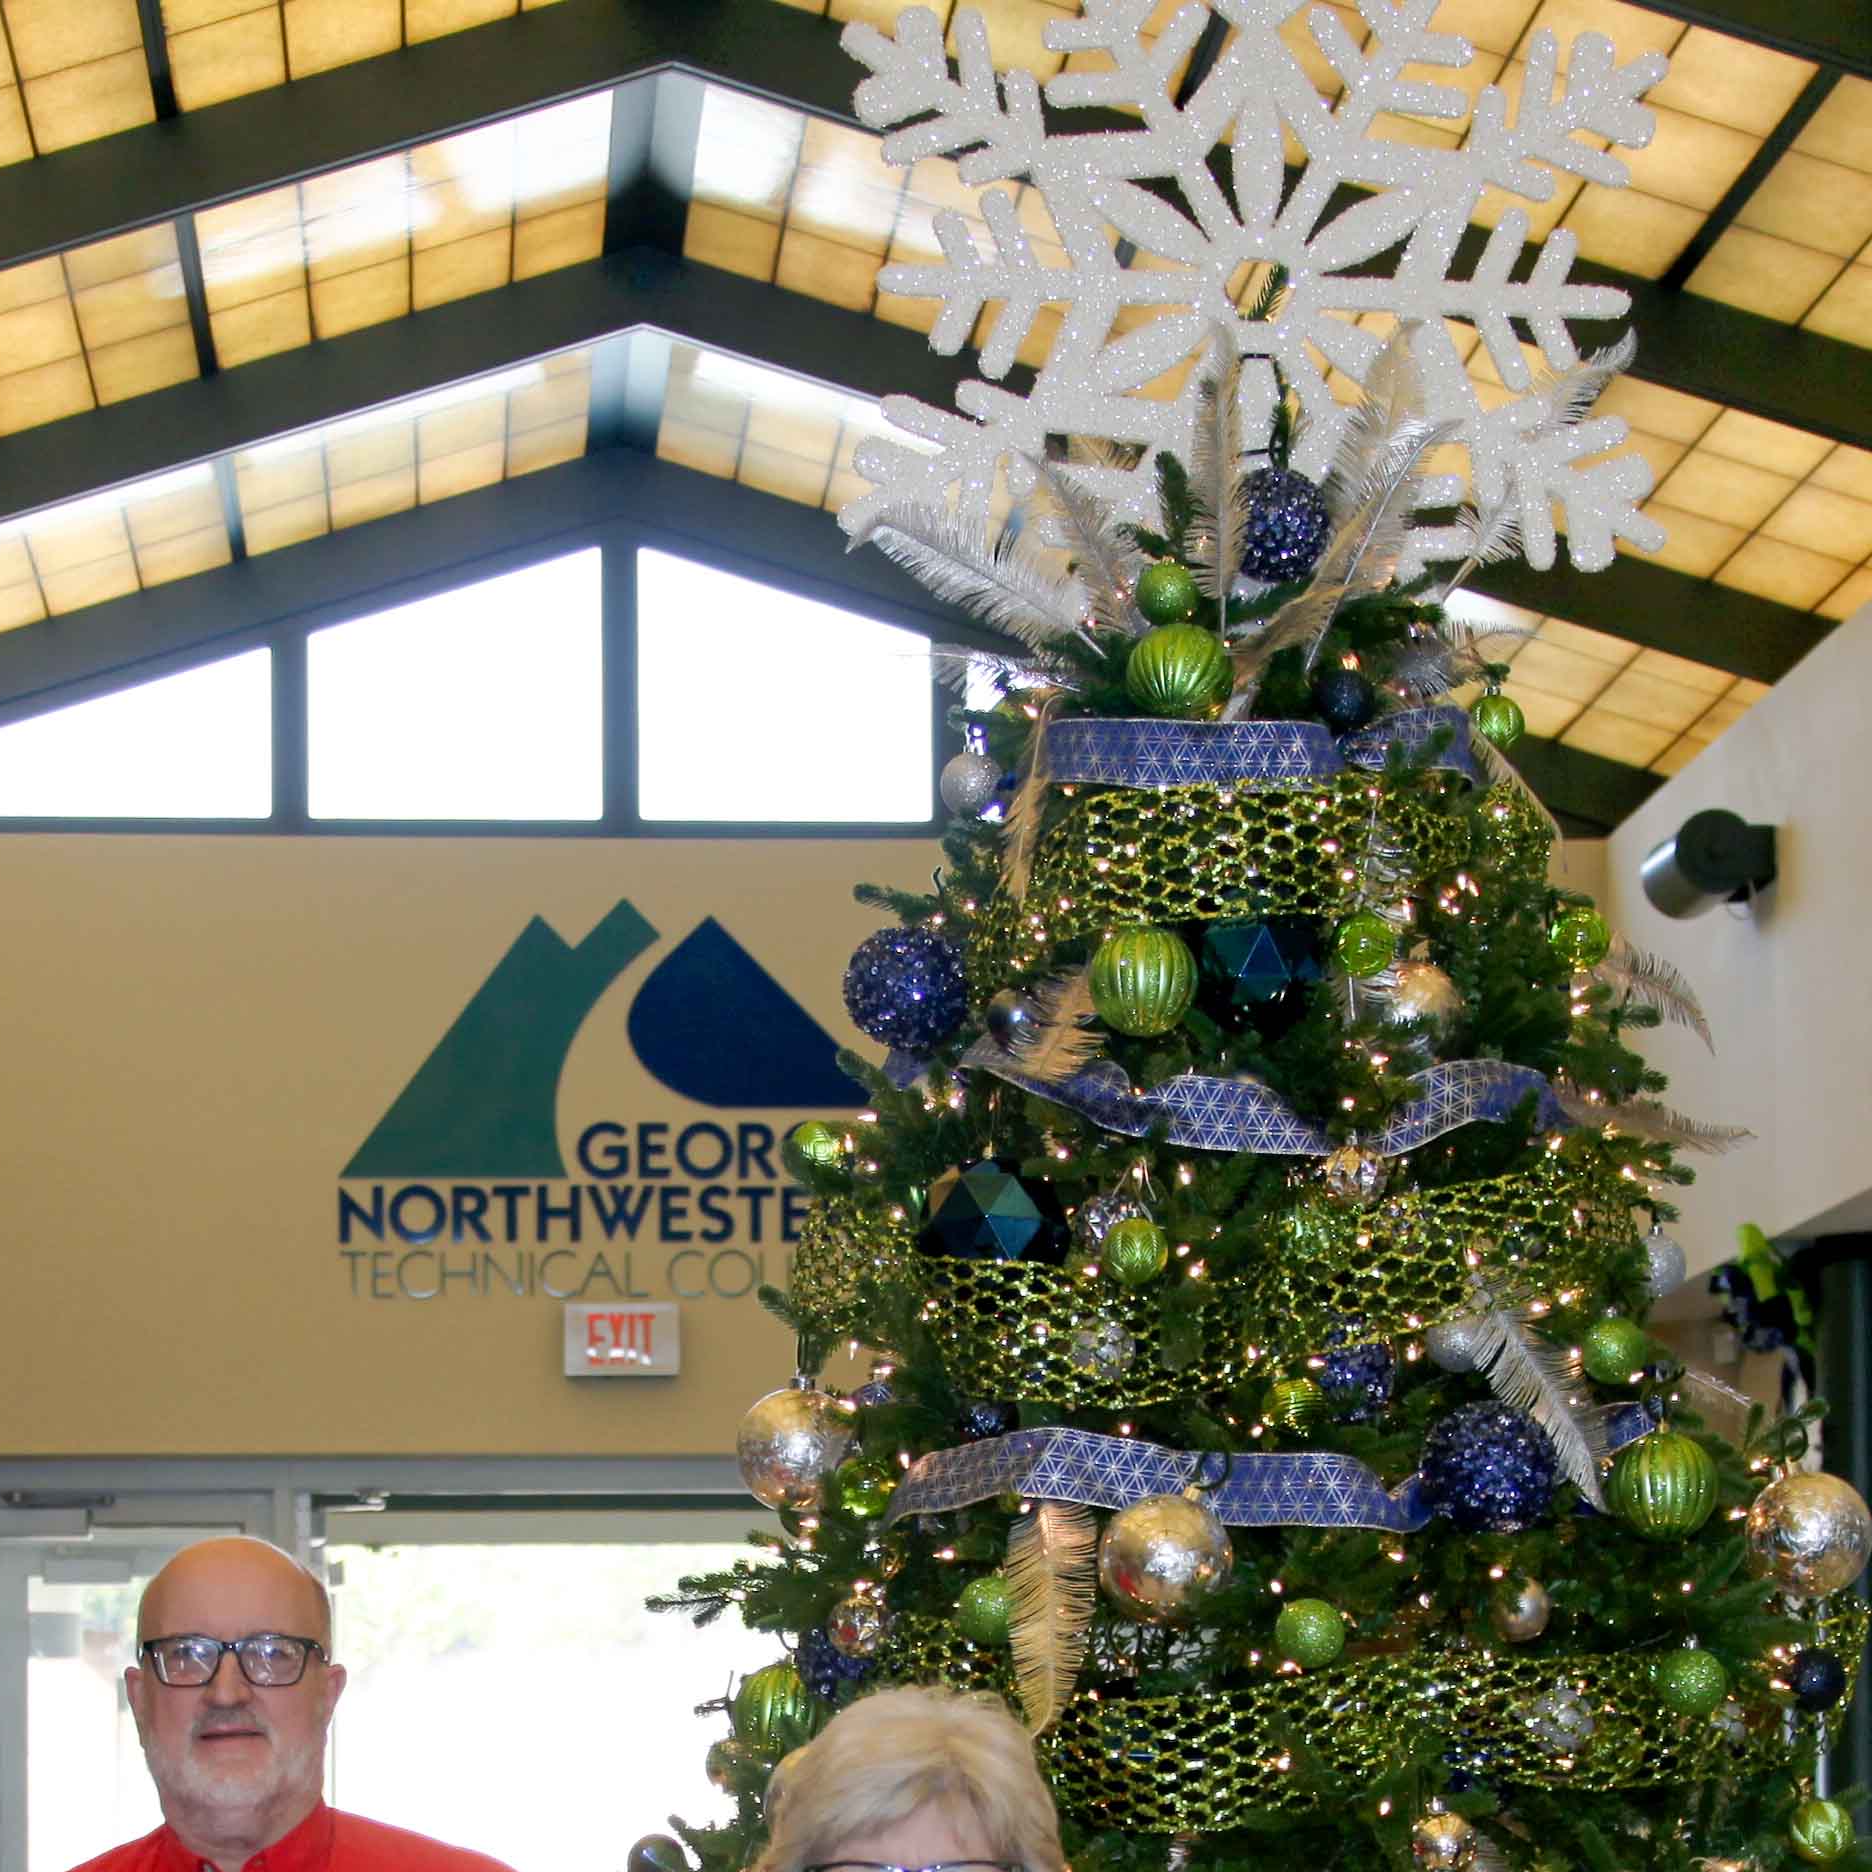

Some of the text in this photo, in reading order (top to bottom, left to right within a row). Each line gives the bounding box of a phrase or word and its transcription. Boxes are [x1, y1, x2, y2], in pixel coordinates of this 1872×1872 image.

[577, 1121, 805, 1180] GEOR
[337, 1184, 813, 1244] NORTHWESTE
[339, 1250, 649, 1298] TECHNICAL
[586, 1311, 657, 1366] EXIT
